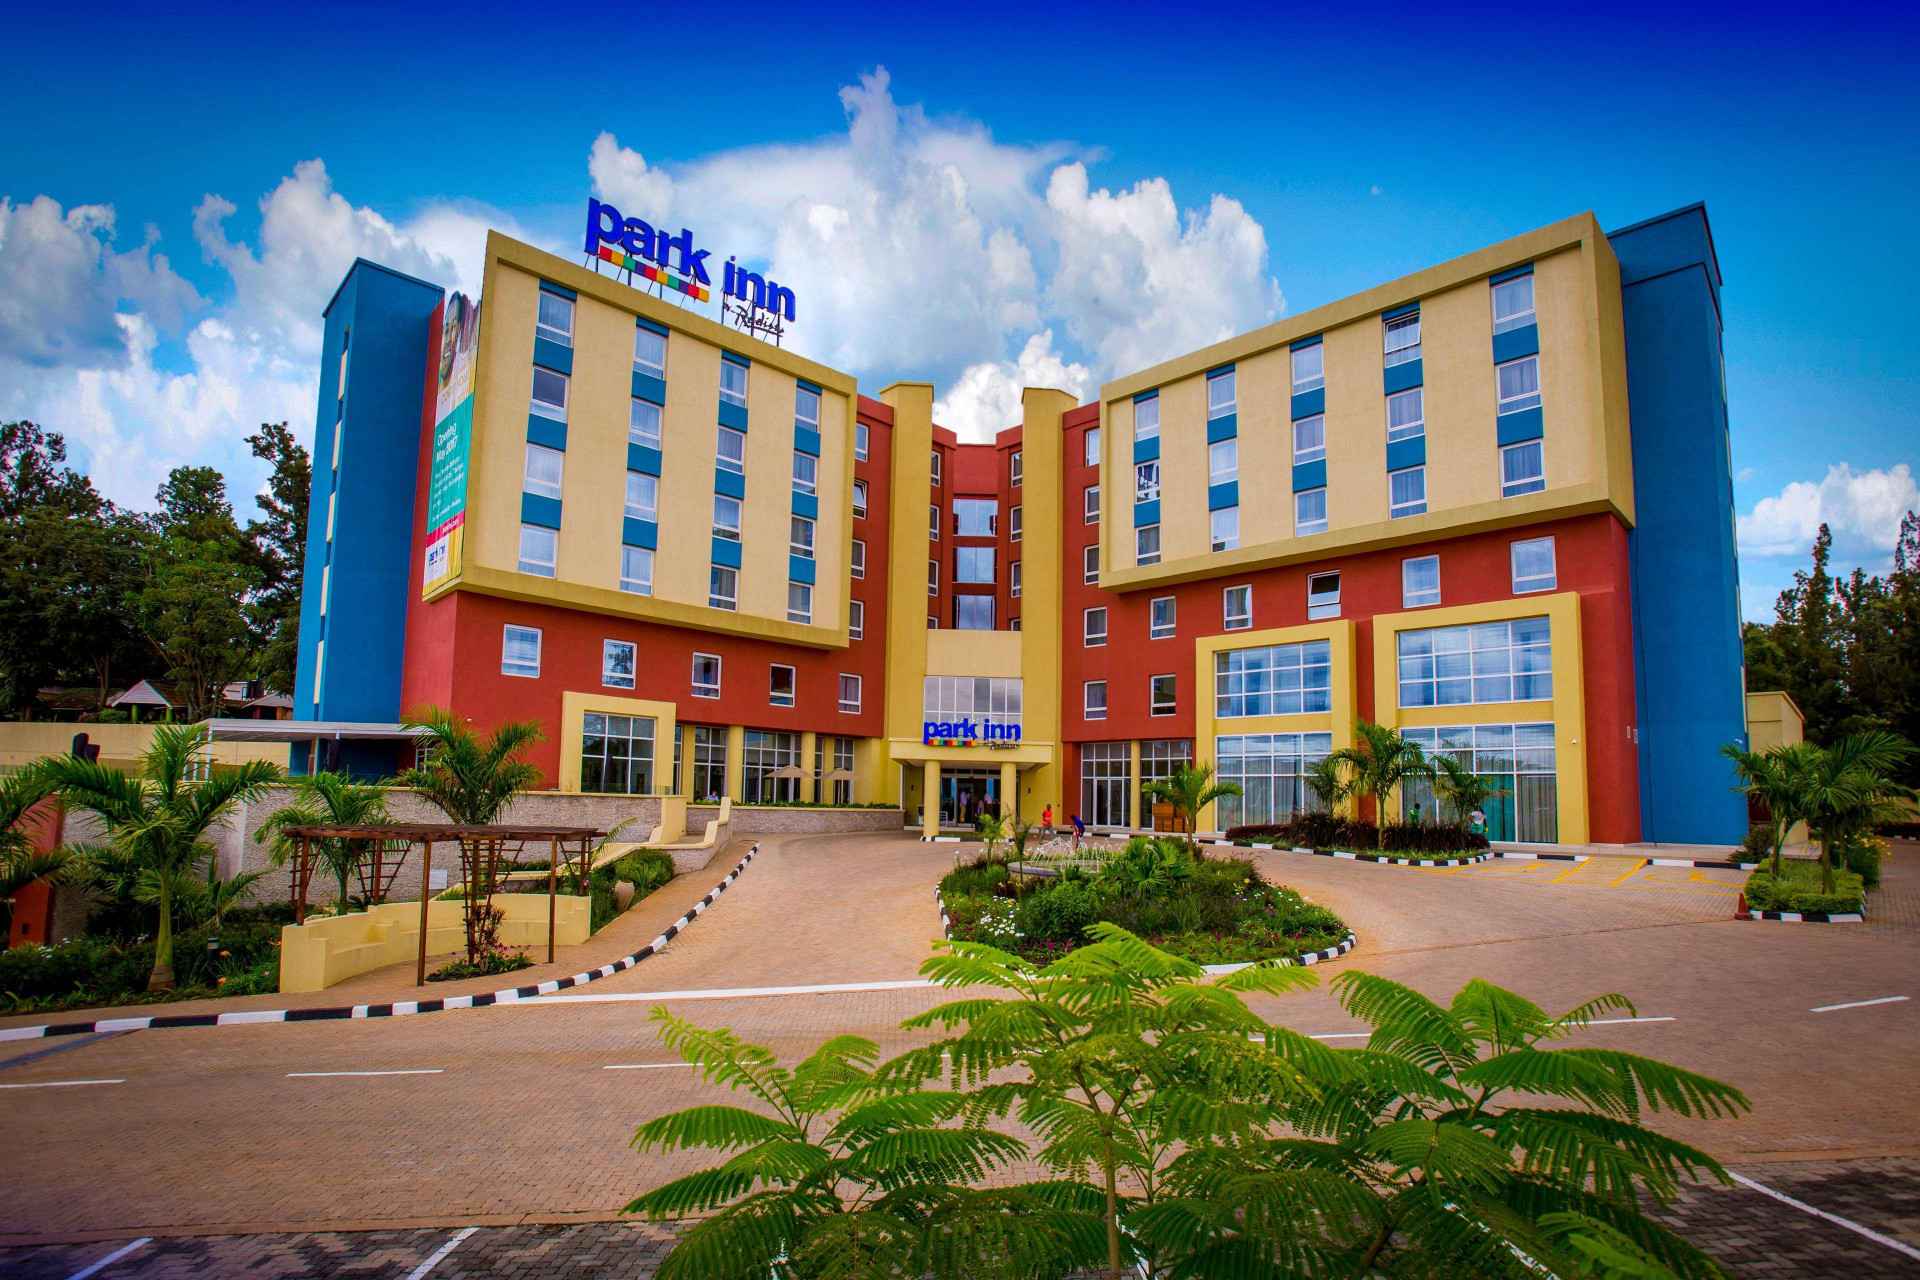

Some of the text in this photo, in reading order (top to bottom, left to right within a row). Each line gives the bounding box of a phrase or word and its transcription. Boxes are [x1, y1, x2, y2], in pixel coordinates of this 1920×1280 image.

[584, 197, 795, 322] park inn
[438, 422, 457, 447] Opening
[923, 718, 1021, 745] park inn
